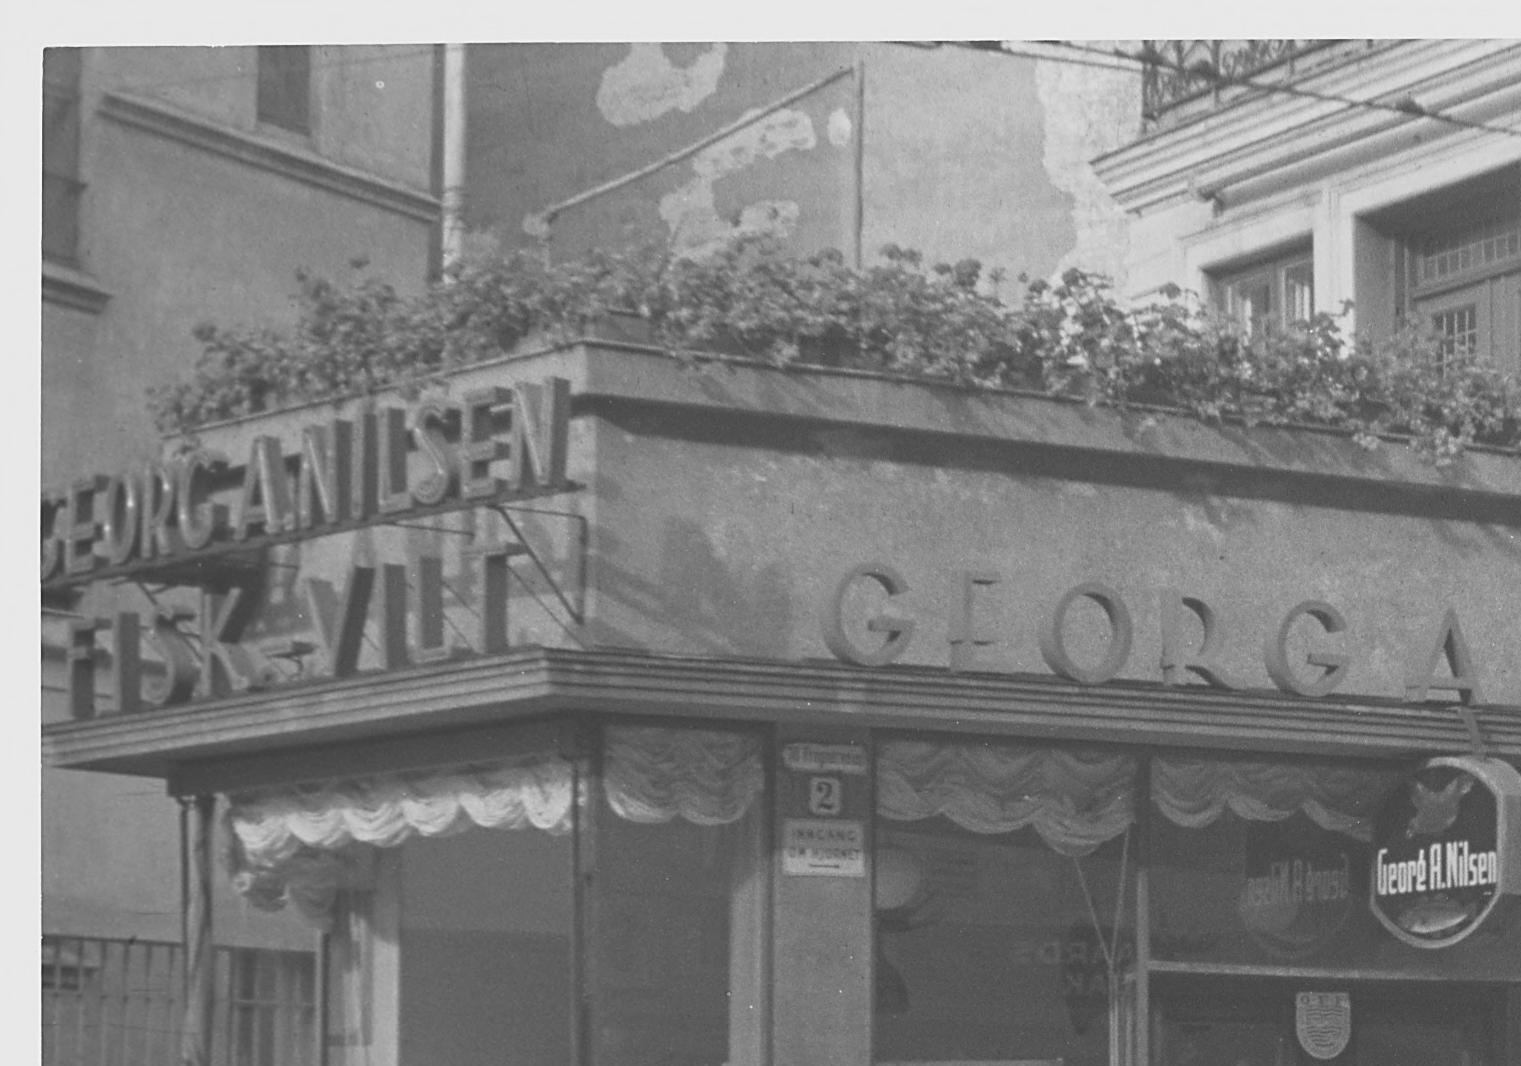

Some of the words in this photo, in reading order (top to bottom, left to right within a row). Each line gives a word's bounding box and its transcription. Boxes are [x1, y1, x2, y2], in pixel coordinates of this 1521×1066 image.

[299, 376, 571, 524] NILSEN
[821, 561, 1351, 698] GEORG
[816, 781, 834, 811] 2
[1377, 848, 1427, 896] Georg
